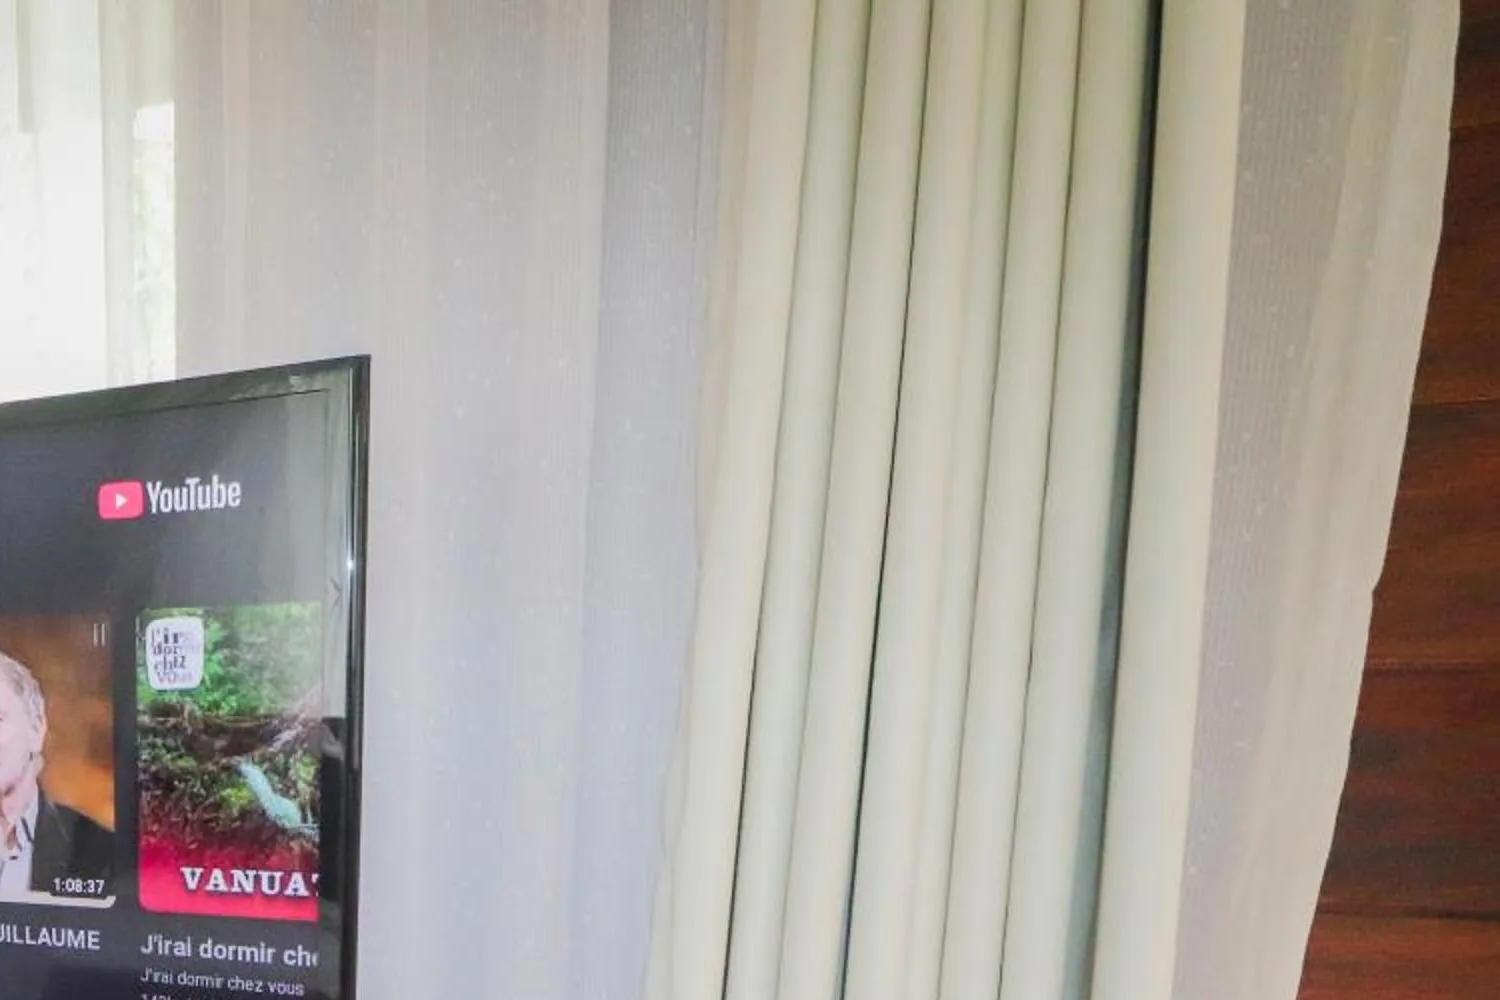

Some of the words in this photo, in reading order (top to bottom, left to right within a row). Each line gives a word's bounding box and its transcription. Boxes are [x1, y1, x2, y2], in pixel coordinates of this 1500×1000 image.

[147, 475, 241, 513] YouTube
[54, 877, 105, 894] 1:08:37
[139, 933, 192, 957] J'irai
[199, 936, 277, 965] dormir
[139, 966, 174, 986] J'irai
[176, 969, 225, 990] dormir
[226, 974, 264, 994] chez
[266, 979, 305, 998] vous
